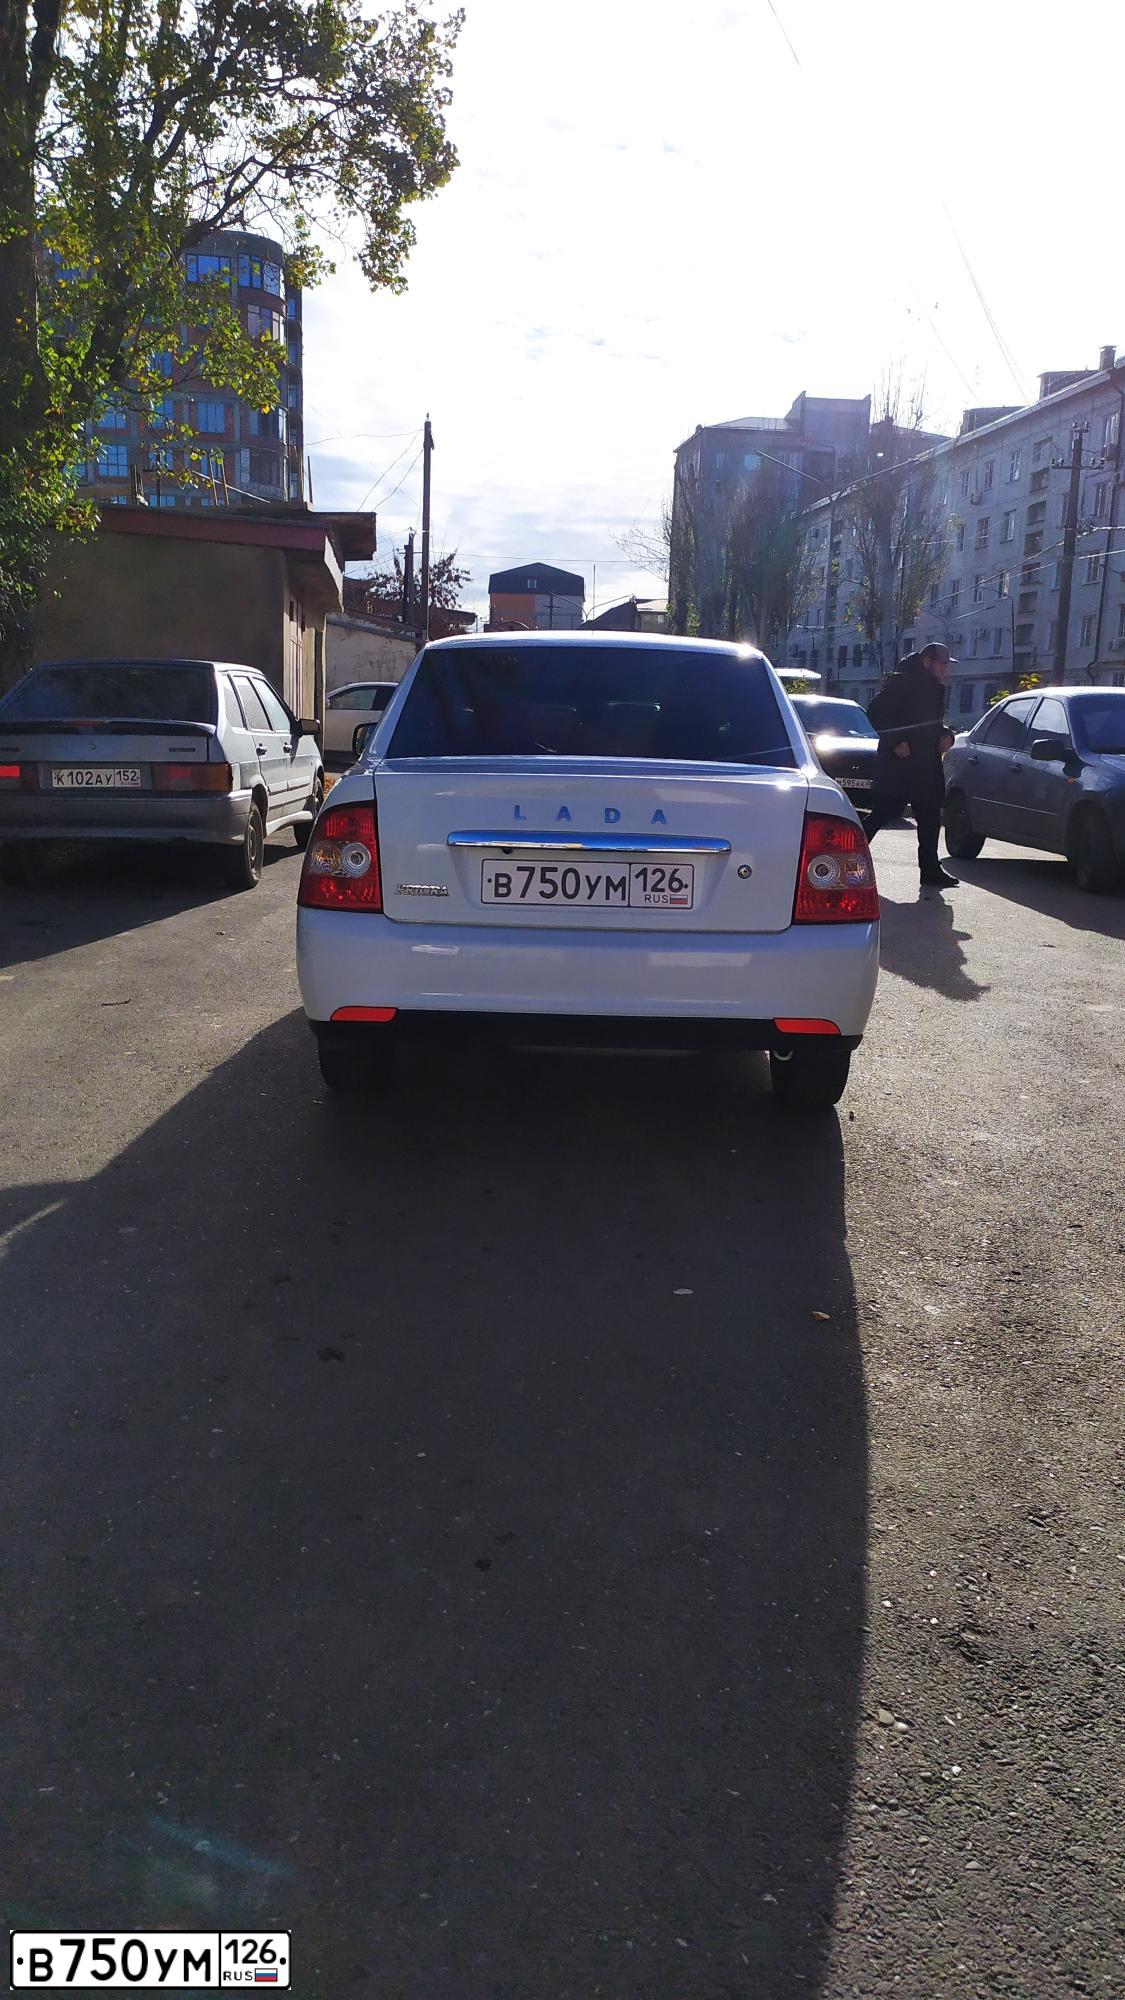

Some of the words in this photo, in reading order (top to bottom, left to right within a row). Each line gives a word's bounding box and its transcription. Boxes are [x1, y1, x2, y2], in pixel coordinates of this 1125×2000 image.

[57, 770, 113, 786] К102АУ
[115, 770, 138, 782] 152
[514, 804, 668, 825] LADA
[493, 866, 628, 901] В750УМ
[634, 867, 684, 893] 126
[644, 893, 669, 904] RUS
